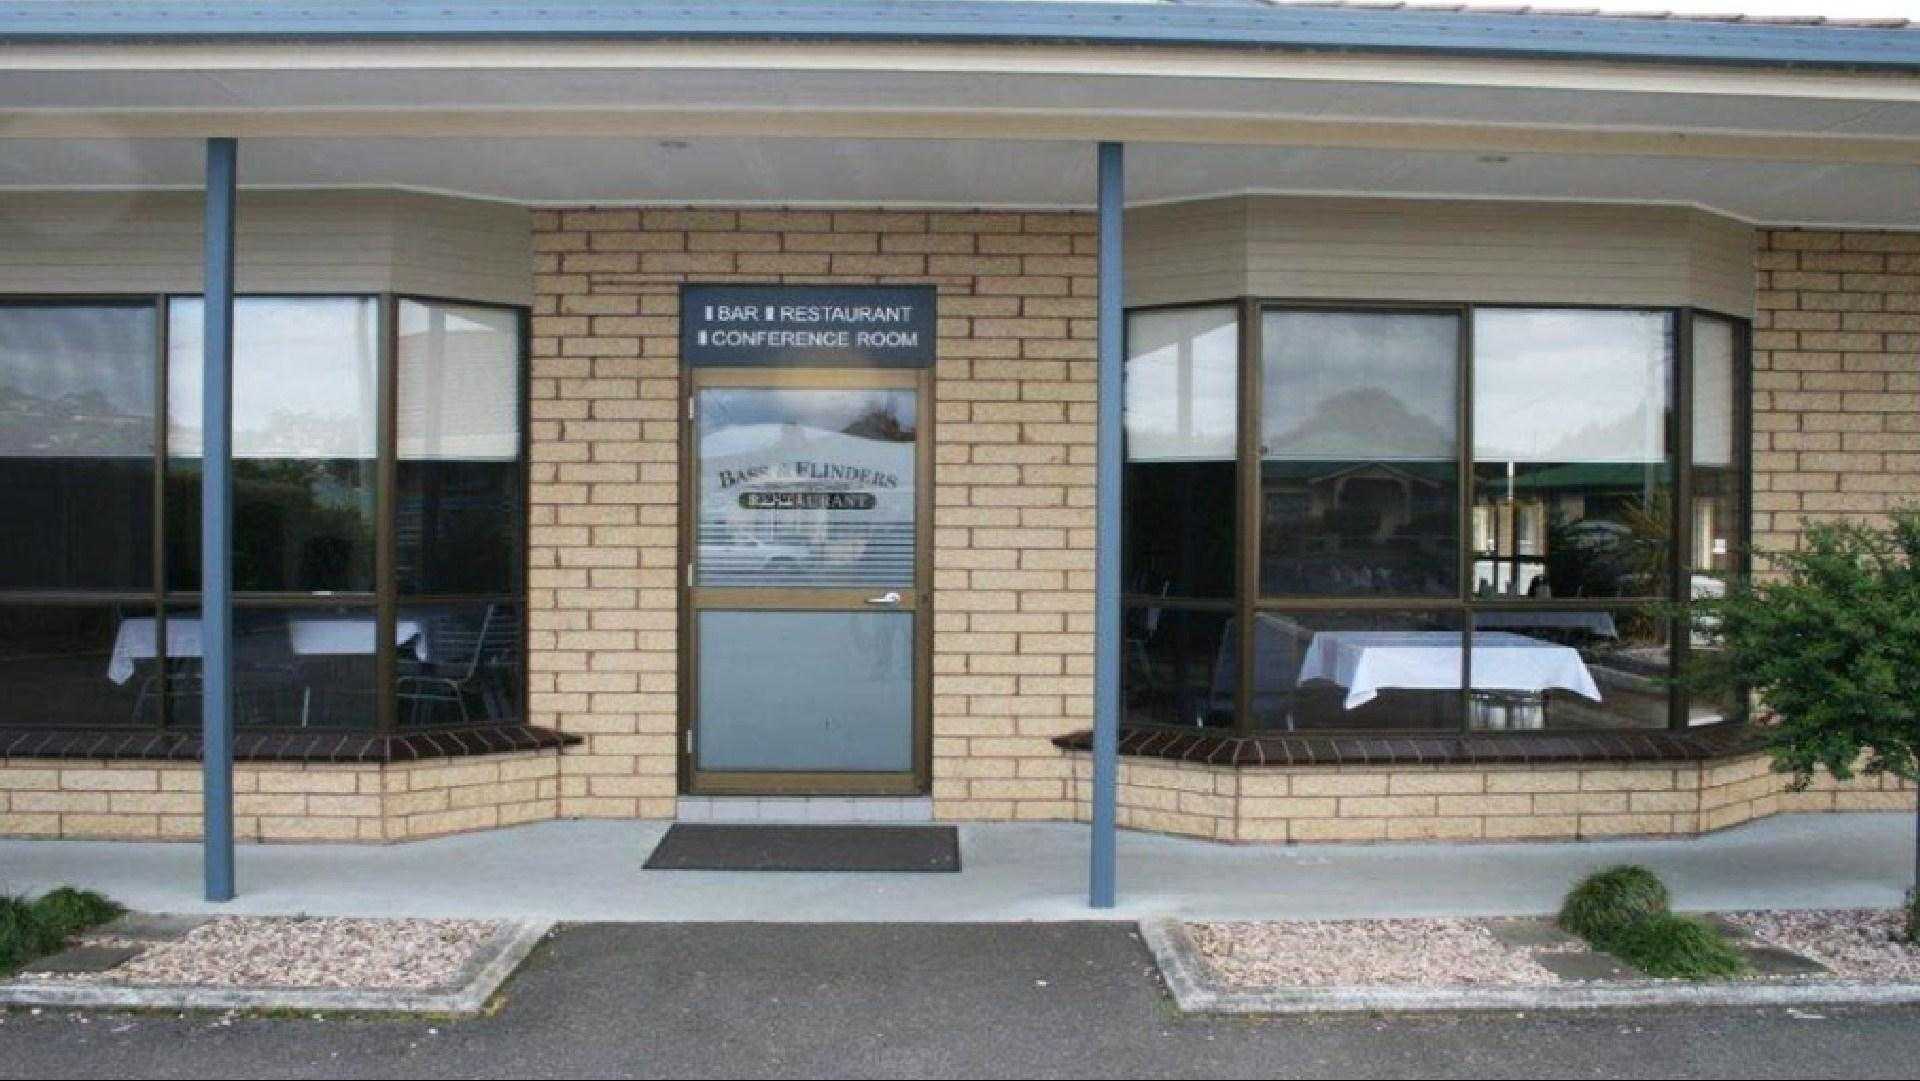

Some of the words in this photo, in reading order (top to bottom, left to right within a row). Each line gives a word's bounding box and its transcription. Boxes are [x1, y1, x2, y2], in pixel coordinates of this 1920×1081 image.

[717, 305, 759, 322] BAR
[780, 305, 913, 322] RESTAURANT
[710, 330, 850, 347] CONFERENCE
[856, 330, 919, 347] ROOM
